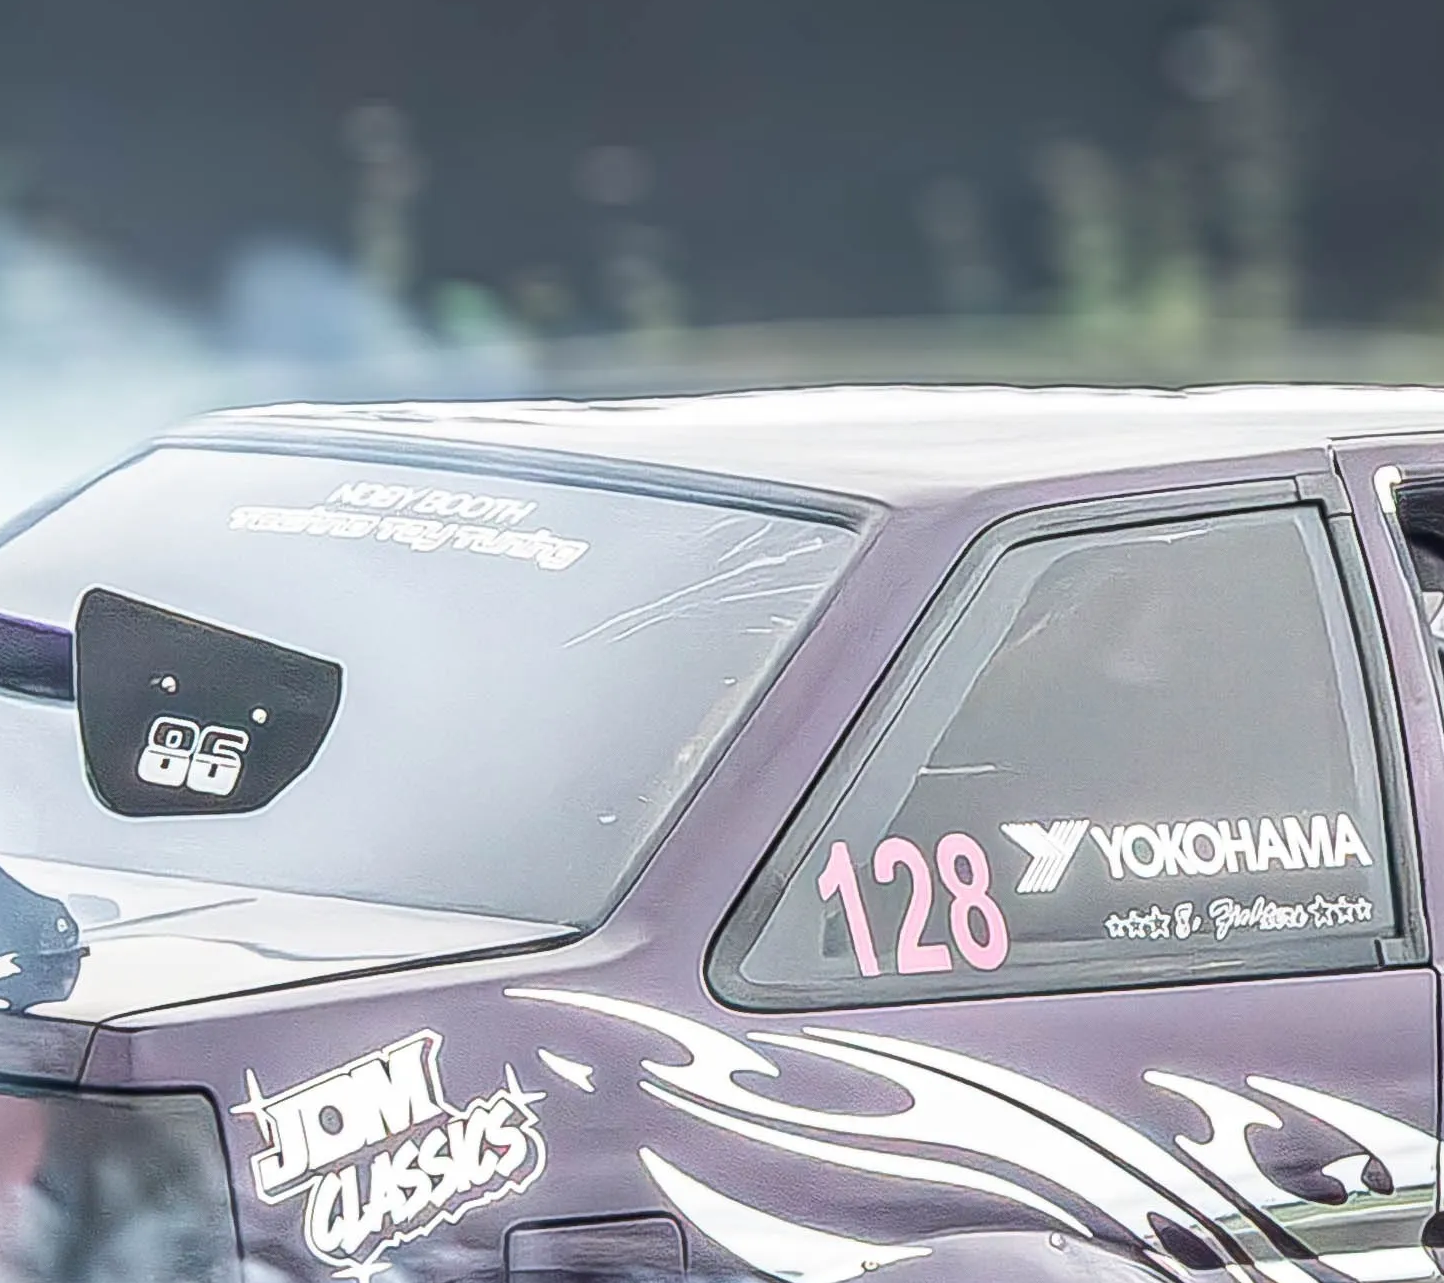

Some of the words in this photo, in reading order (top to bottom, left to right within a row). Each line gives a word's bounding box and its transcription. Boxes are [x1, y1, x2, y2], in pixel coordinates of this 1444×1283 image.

[415, 488, 537, 525] BOOTH
[137, 716, 250, 796] 86
[1089, 813, 1373, 881] YOKOHAMA
[817, 832, 1010, 977] 128
[258, 1038, 445, 1191] JDM
[310, 1098, 528, 1255] CLASSICS
